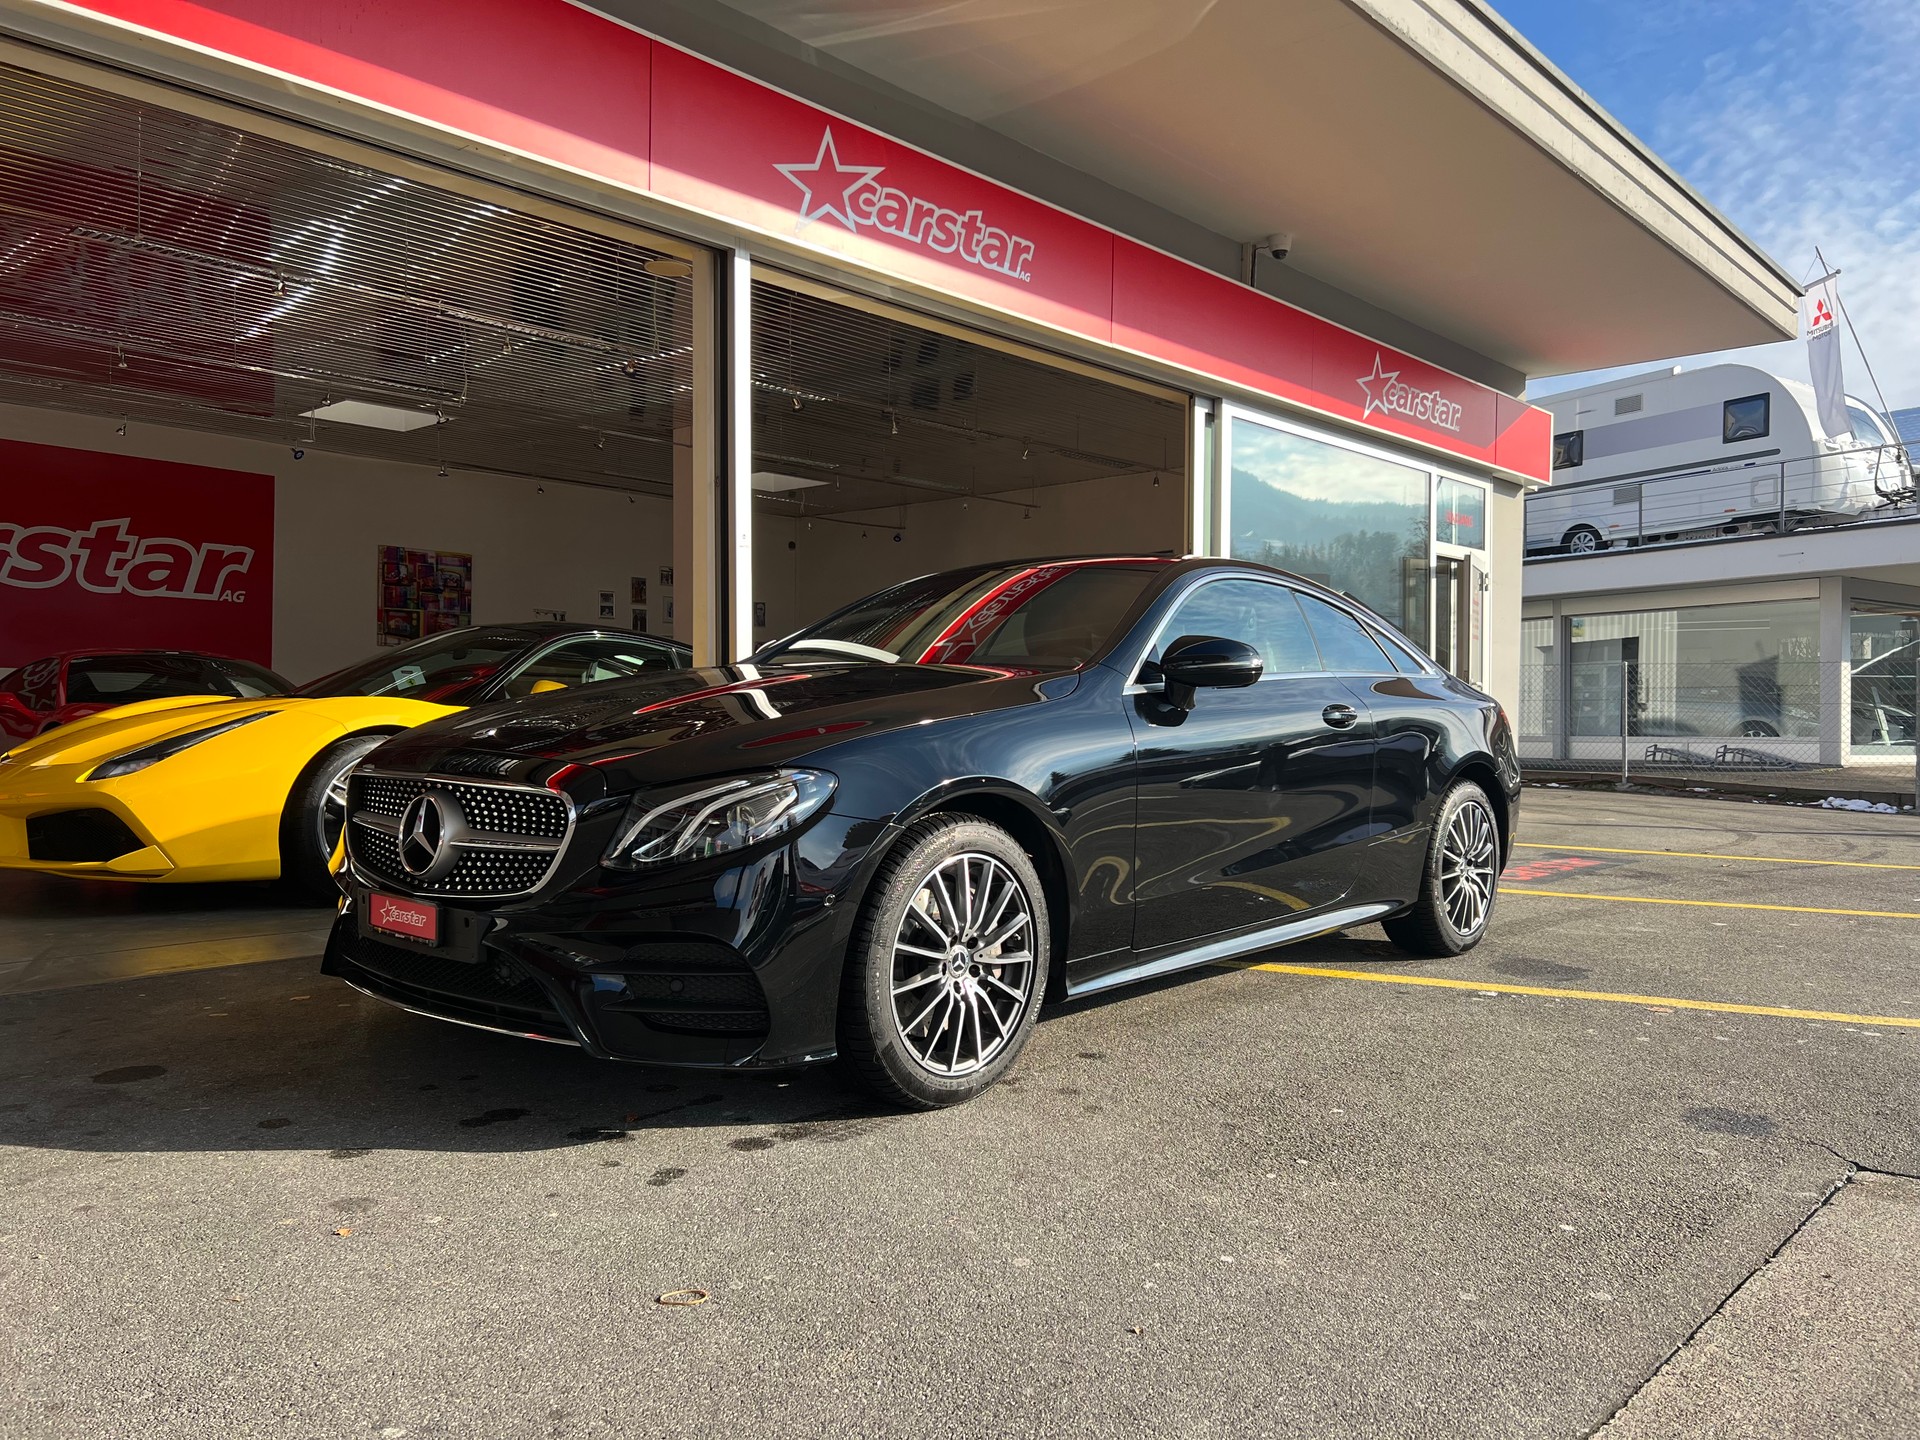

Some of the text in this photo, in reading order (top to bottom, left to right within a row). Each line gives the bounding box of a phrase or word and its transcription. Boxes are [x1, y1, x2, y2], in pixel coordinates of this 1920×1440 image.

[845, 179, 1035, 283] carstar AG
[1384, 380, 1462, 430] carstar
[219, 590, 247, 603] AG
[390, 908, 427, 927] carstar
